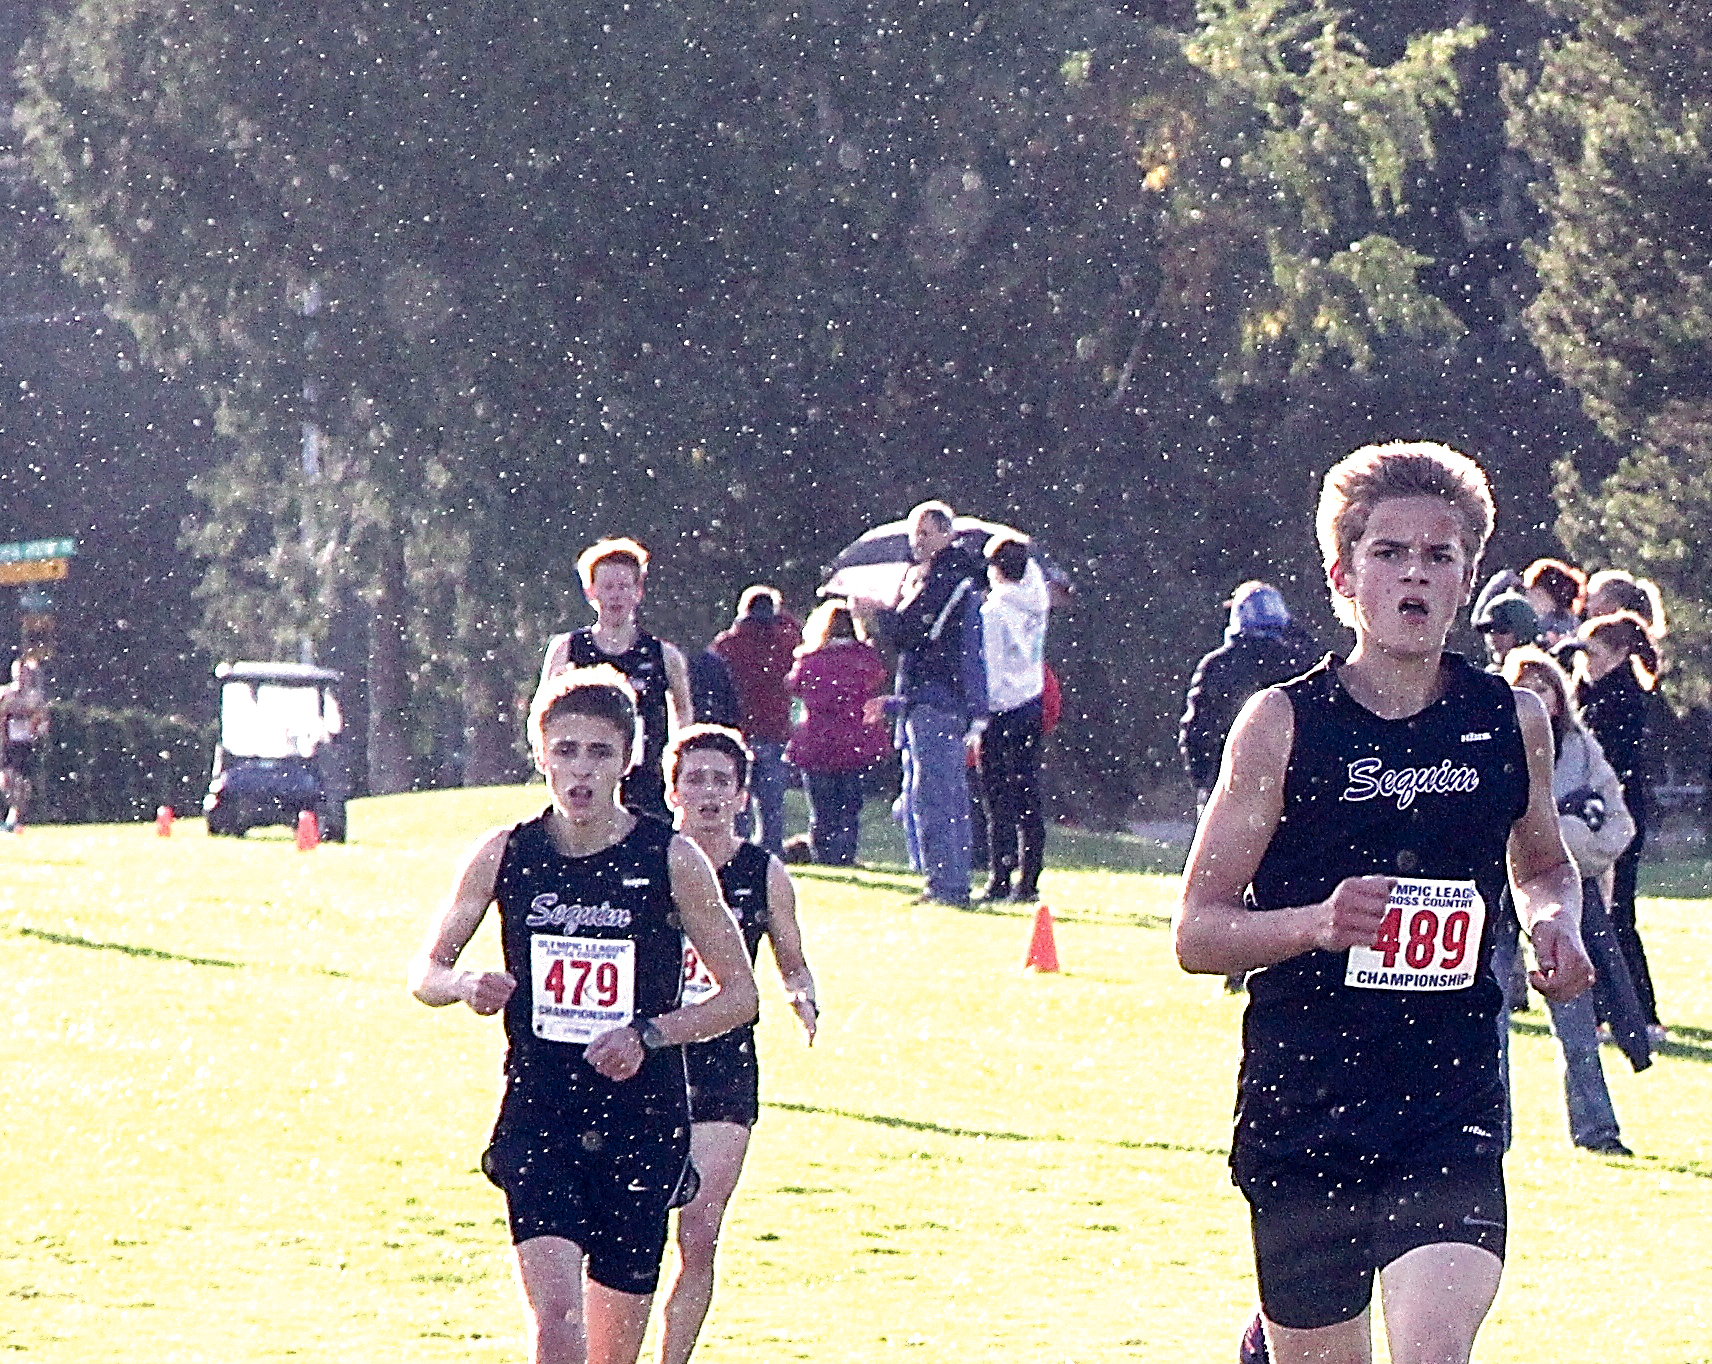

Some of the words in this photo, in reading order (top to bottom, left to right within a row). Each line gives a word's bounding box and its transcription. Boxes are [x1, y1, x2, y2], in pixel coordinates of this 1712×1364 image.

[1343, 757, 1479, 810] Sequim
[1389, 895, 1419, 906] ROSS
[1396, 884, 1432, 898] MPIC
[525, 892, 632, 936] Sequim
[1370, 907, 1471, 970] 489
[545, 959, 618, 1007] 479
[1356, 970, 1469, 988] CHAMPIONSHIP
